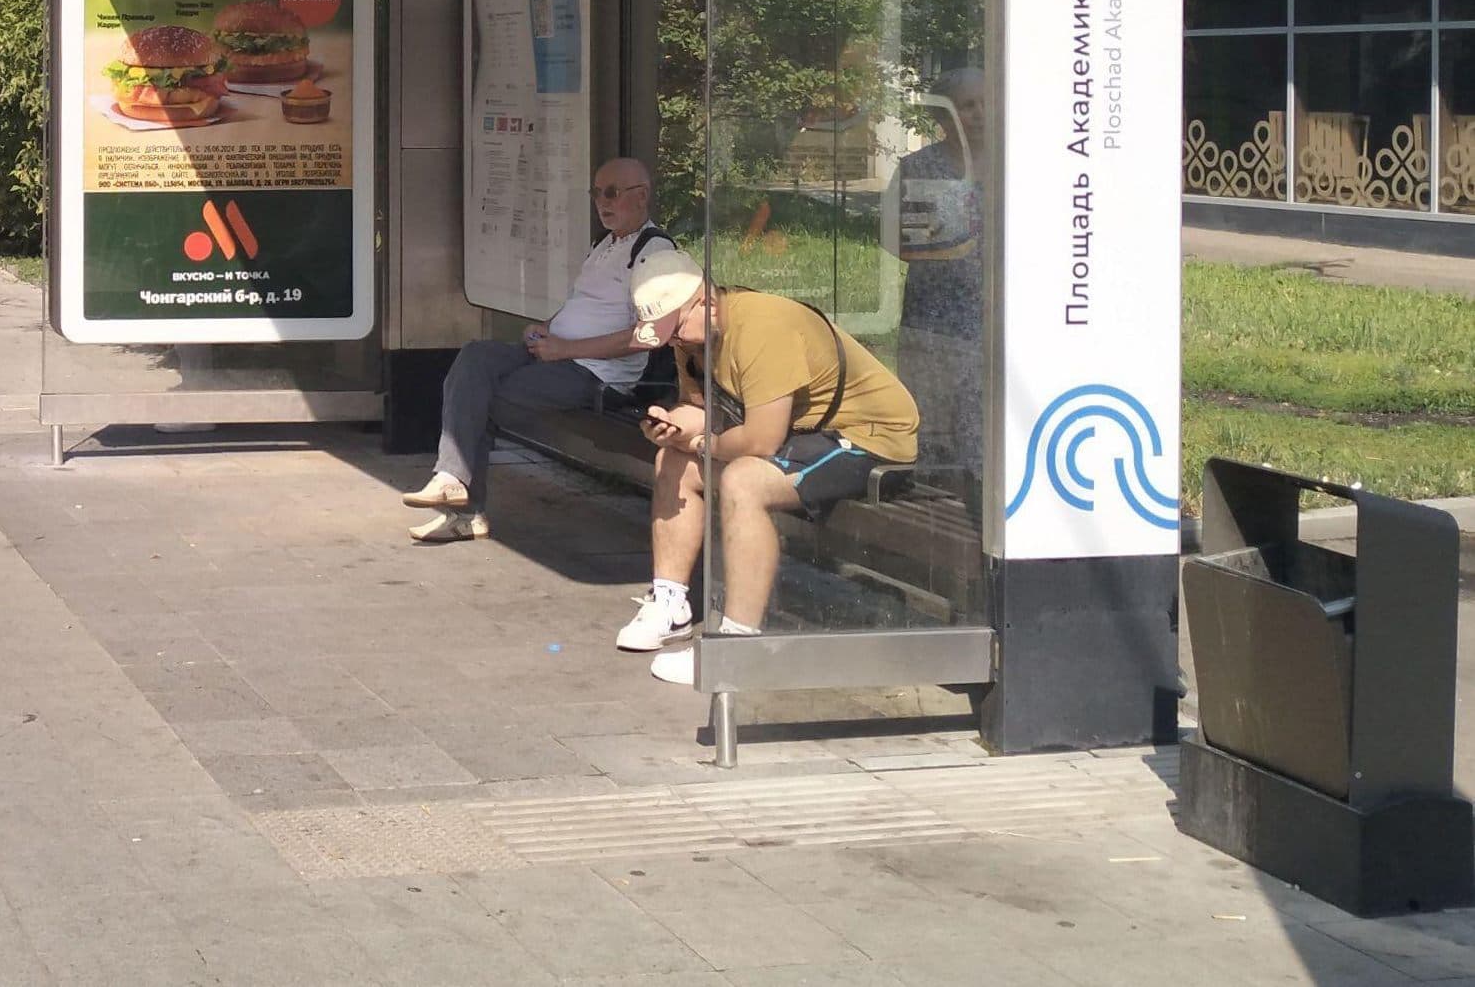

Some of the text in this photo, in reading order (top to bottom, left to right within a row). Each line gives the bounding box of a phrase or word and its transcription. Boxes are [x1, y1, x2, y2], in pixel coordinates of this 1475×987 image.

[1103, 48, 1122, 150] Ploschad
[172, 272, 215, 282] ВКУСНО
[225, 272, 233, 280] И
[235, 271, 271, 280] ТОЧКА
[1065, 173, 1093, 325] Площадь
[140, 288, 303, 307] Чонгарский б-р, д. 19
